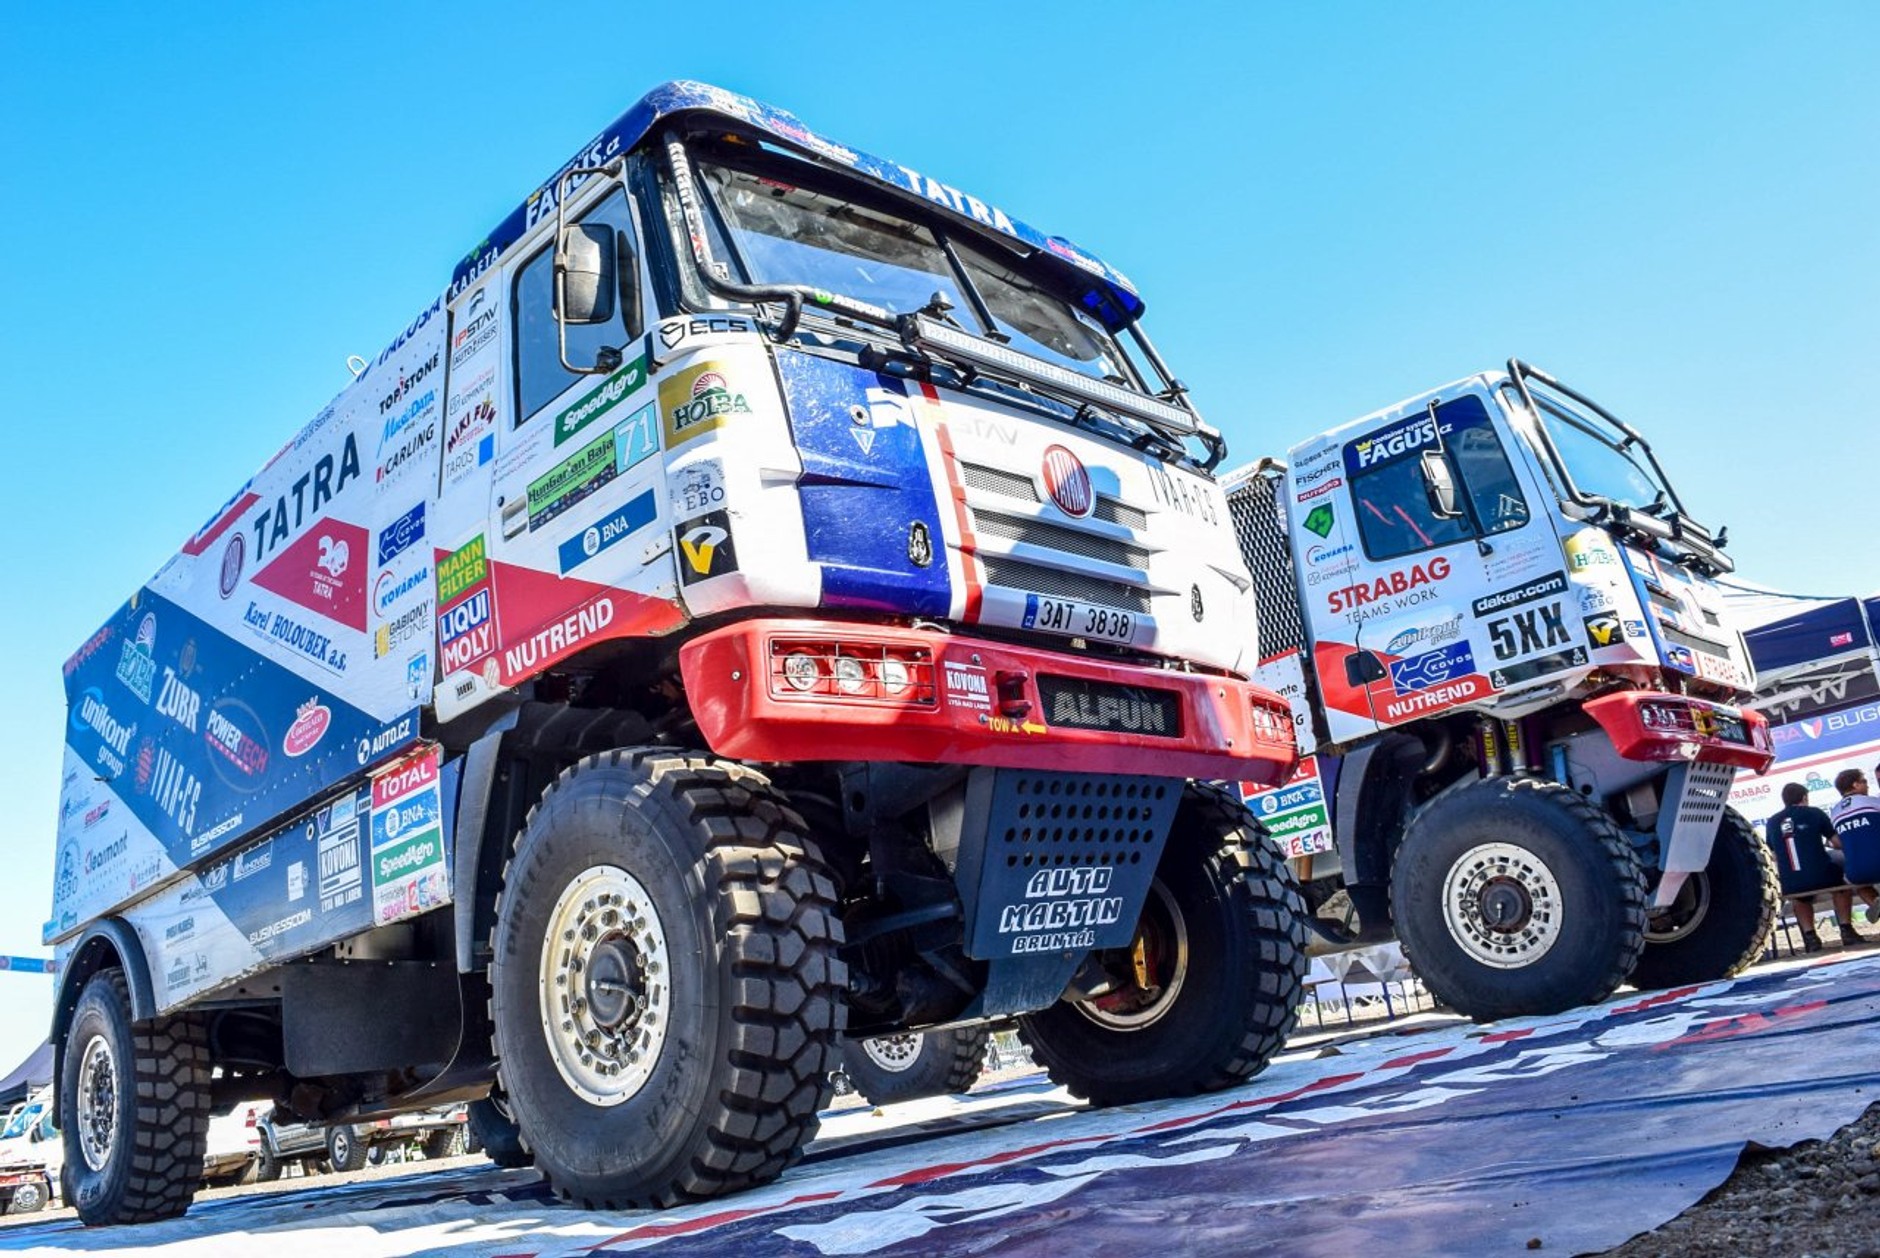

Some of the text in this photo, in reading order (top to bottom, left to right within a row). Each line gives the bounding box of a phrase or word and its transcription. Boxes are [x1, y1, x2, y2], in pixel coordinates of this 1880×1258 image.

[899, 165, 1018, 235] TATRA
[452, 247, 499, 298] KARETA
[690, 319, 748, 334] ECS
[562, 368, 639, 432] SpeedAgro
[674, 394, 752, 431] HOLBA
[384, 423, 435, 475] CARLING
[618, 410, 654, 466] 71
[1358, 422, 1453, 469] FAGUScz
[1295, 460, 1341, 486] FISCHER
[254, 432, 360, 562] TATRA
[603, 516, 630, 543] BNA
[439, 540, 483, 580] MANN
[440, 563, 485, 601] FILTER
[1327, 556, 1451, 614] STRABAG
[1476, 576, 1563, 613] dakar.com
[389, 601, 429, 635] GABIONY
[441, 590, 488, 642] LIQUI
[1040, 601, 1075, 629] 3AT
[1085, 608, 1130, 638] 3838
[1345, 586, 1439, 625] TEAMS WORK
[243, 601, 268, 631] Karel
[273, 613, 332, 662] HOLOUBEK
[444, 624, 492, 674] MOLY
[506, 598, 614, 678] NUTREND
[1487, 602, 1571, 661] 5XX
[156, 666, 200, 734] ZUBR
[946, 670, 987, 694] KOVONA
[1387, 680, 1476, 719] NUTREND
[81, 696, 132, 757] unikont
[988, 717, 1010, 733] TOW
[1053, 691, 1165, 732] ALFUN
[380, 763, 431, 800] TOTAL
[1280, 790, 1304, 807] BNA
[402, 804, 424, 828] BNA
[1268, 812, 1318, 834] eedAgro
[322, 837, 357, 878] KOVONA
[380, 840, 434, 878] SpeedAgro
[1025, 866, 1113, 898] AUTO
[999, 897, 1123, 933] MARTIN
